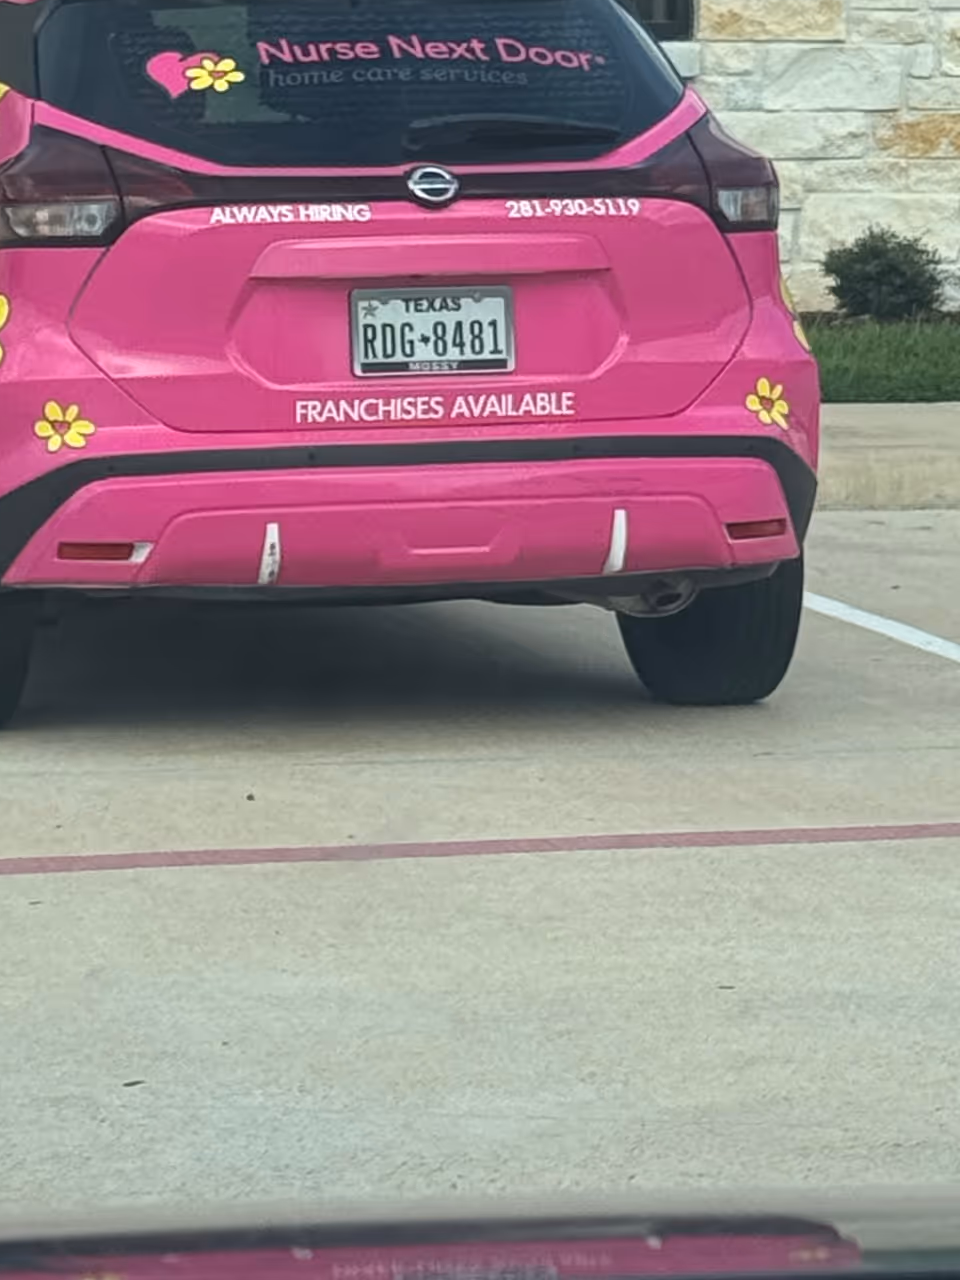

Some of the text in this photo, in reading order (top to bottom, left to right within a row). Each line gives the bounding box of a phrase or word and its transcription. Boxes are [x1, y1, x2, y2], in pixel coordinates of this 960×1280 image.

[256, 34, 596, 72] Nurse Next Door
[269, 67, 530, 87] home care services
[210, 204, 372, 224] ALWAYS HIRING
[505, 198, 641, 218] 281-930-5119
[401, 296, 462, 313] TEXAS
[295, 392, 576, 423] FRANCHISES AVAILABLE
